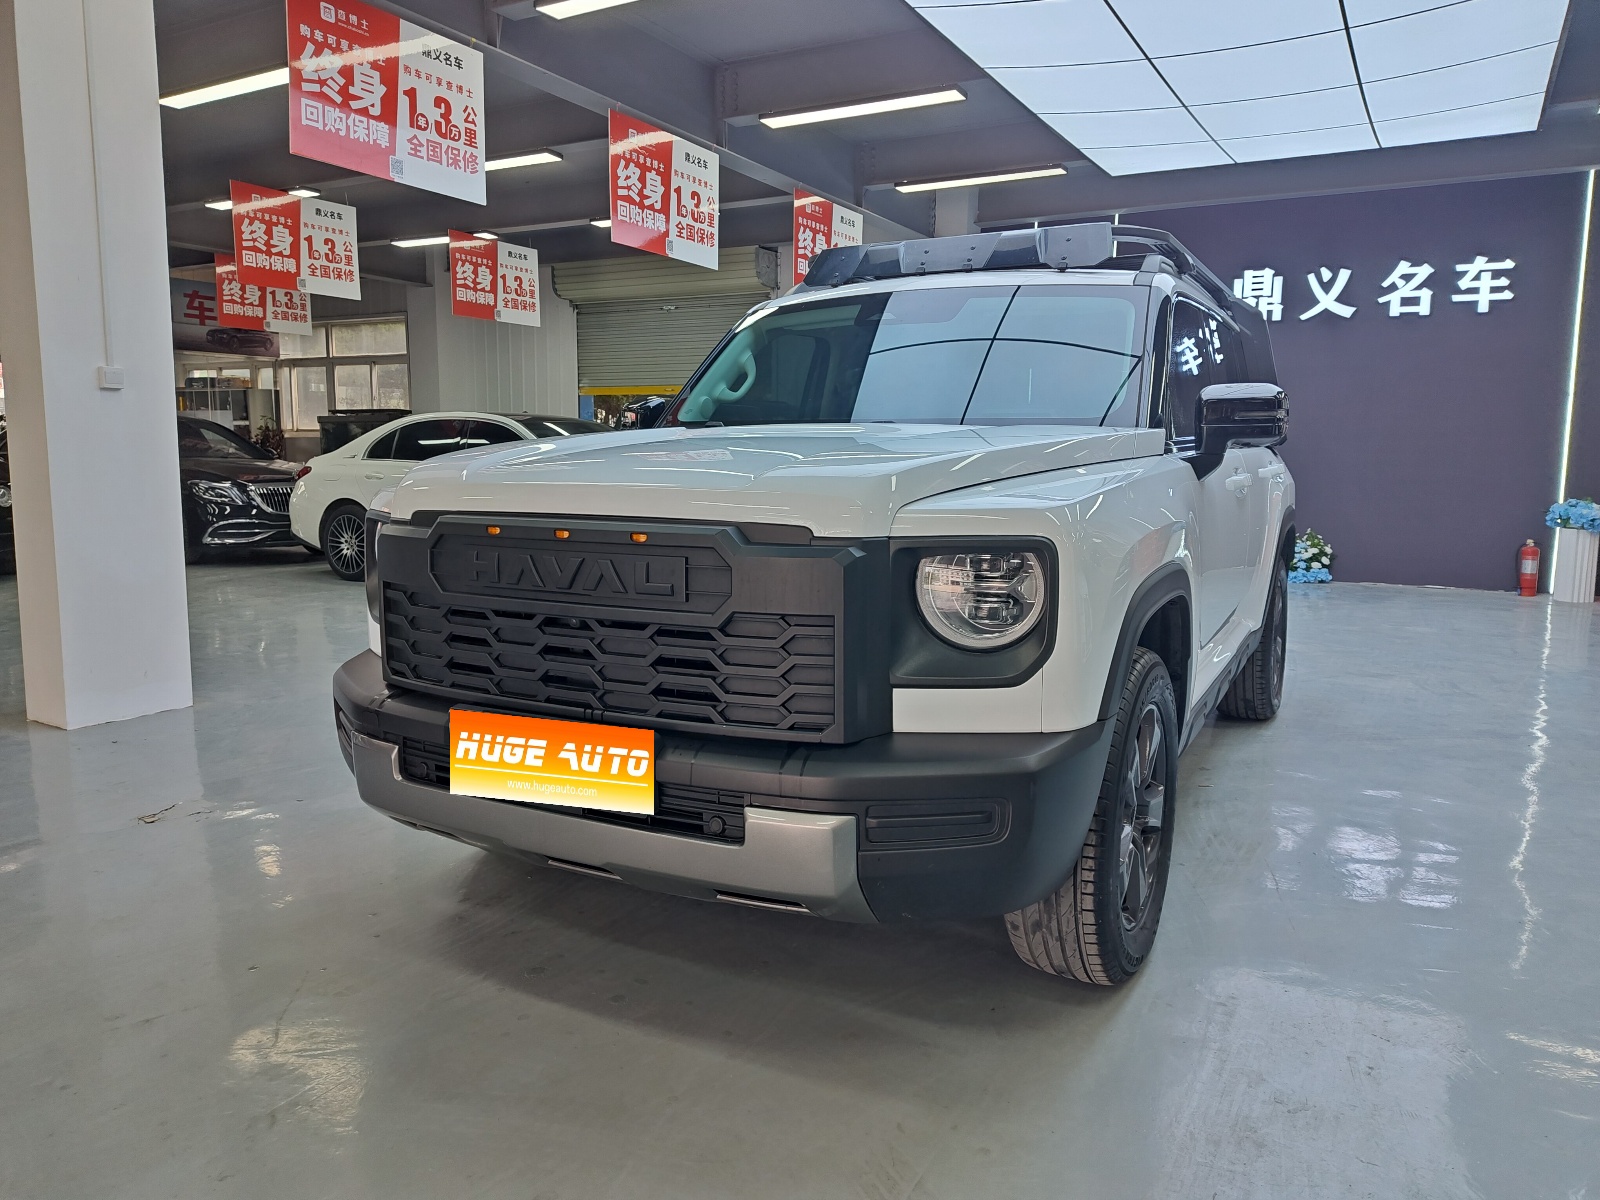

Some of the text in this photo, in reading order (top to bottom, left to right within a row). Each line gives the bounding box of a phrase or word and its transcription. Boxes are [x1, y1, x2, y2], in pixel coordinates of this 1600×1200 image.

[422, 43, 464, 71] 鼎义名车
[300, 41, 387, 116] 终身
[403, 63, 474, 99] 购车可享查博士
[300, 98, 390, 148] 回购保障
[406, 133, 479, 175] 全国保修
[684, 151, 709, 170] 鼎义名车
[616, 158, 665, 210] 终身
[315, 207, 344, 221] 鼎义名车
[617, 200, 667, 233] 回购保障
[241, 218, 294, 256] 终身
[675, 220, 715, 248] 全国保修
[242, 250, 297, 274] 回购保障
[308, 263, 355, 283] 全国保修
[455, 260, 493, 291] 终身
[222, 279, 262, 306] 终身
[456, 286, 495, 307] 回购保障
[1233, 254, 1517, 322] 鼎义名车
[183, 289, 218, 326] 车
[222, 302, 264, 318] 回购保障
[271, 309, 309, 324] 全国保修
[502, 296, 537, 313] 全国保修
[468, 549, 675, 597] HAVAL
